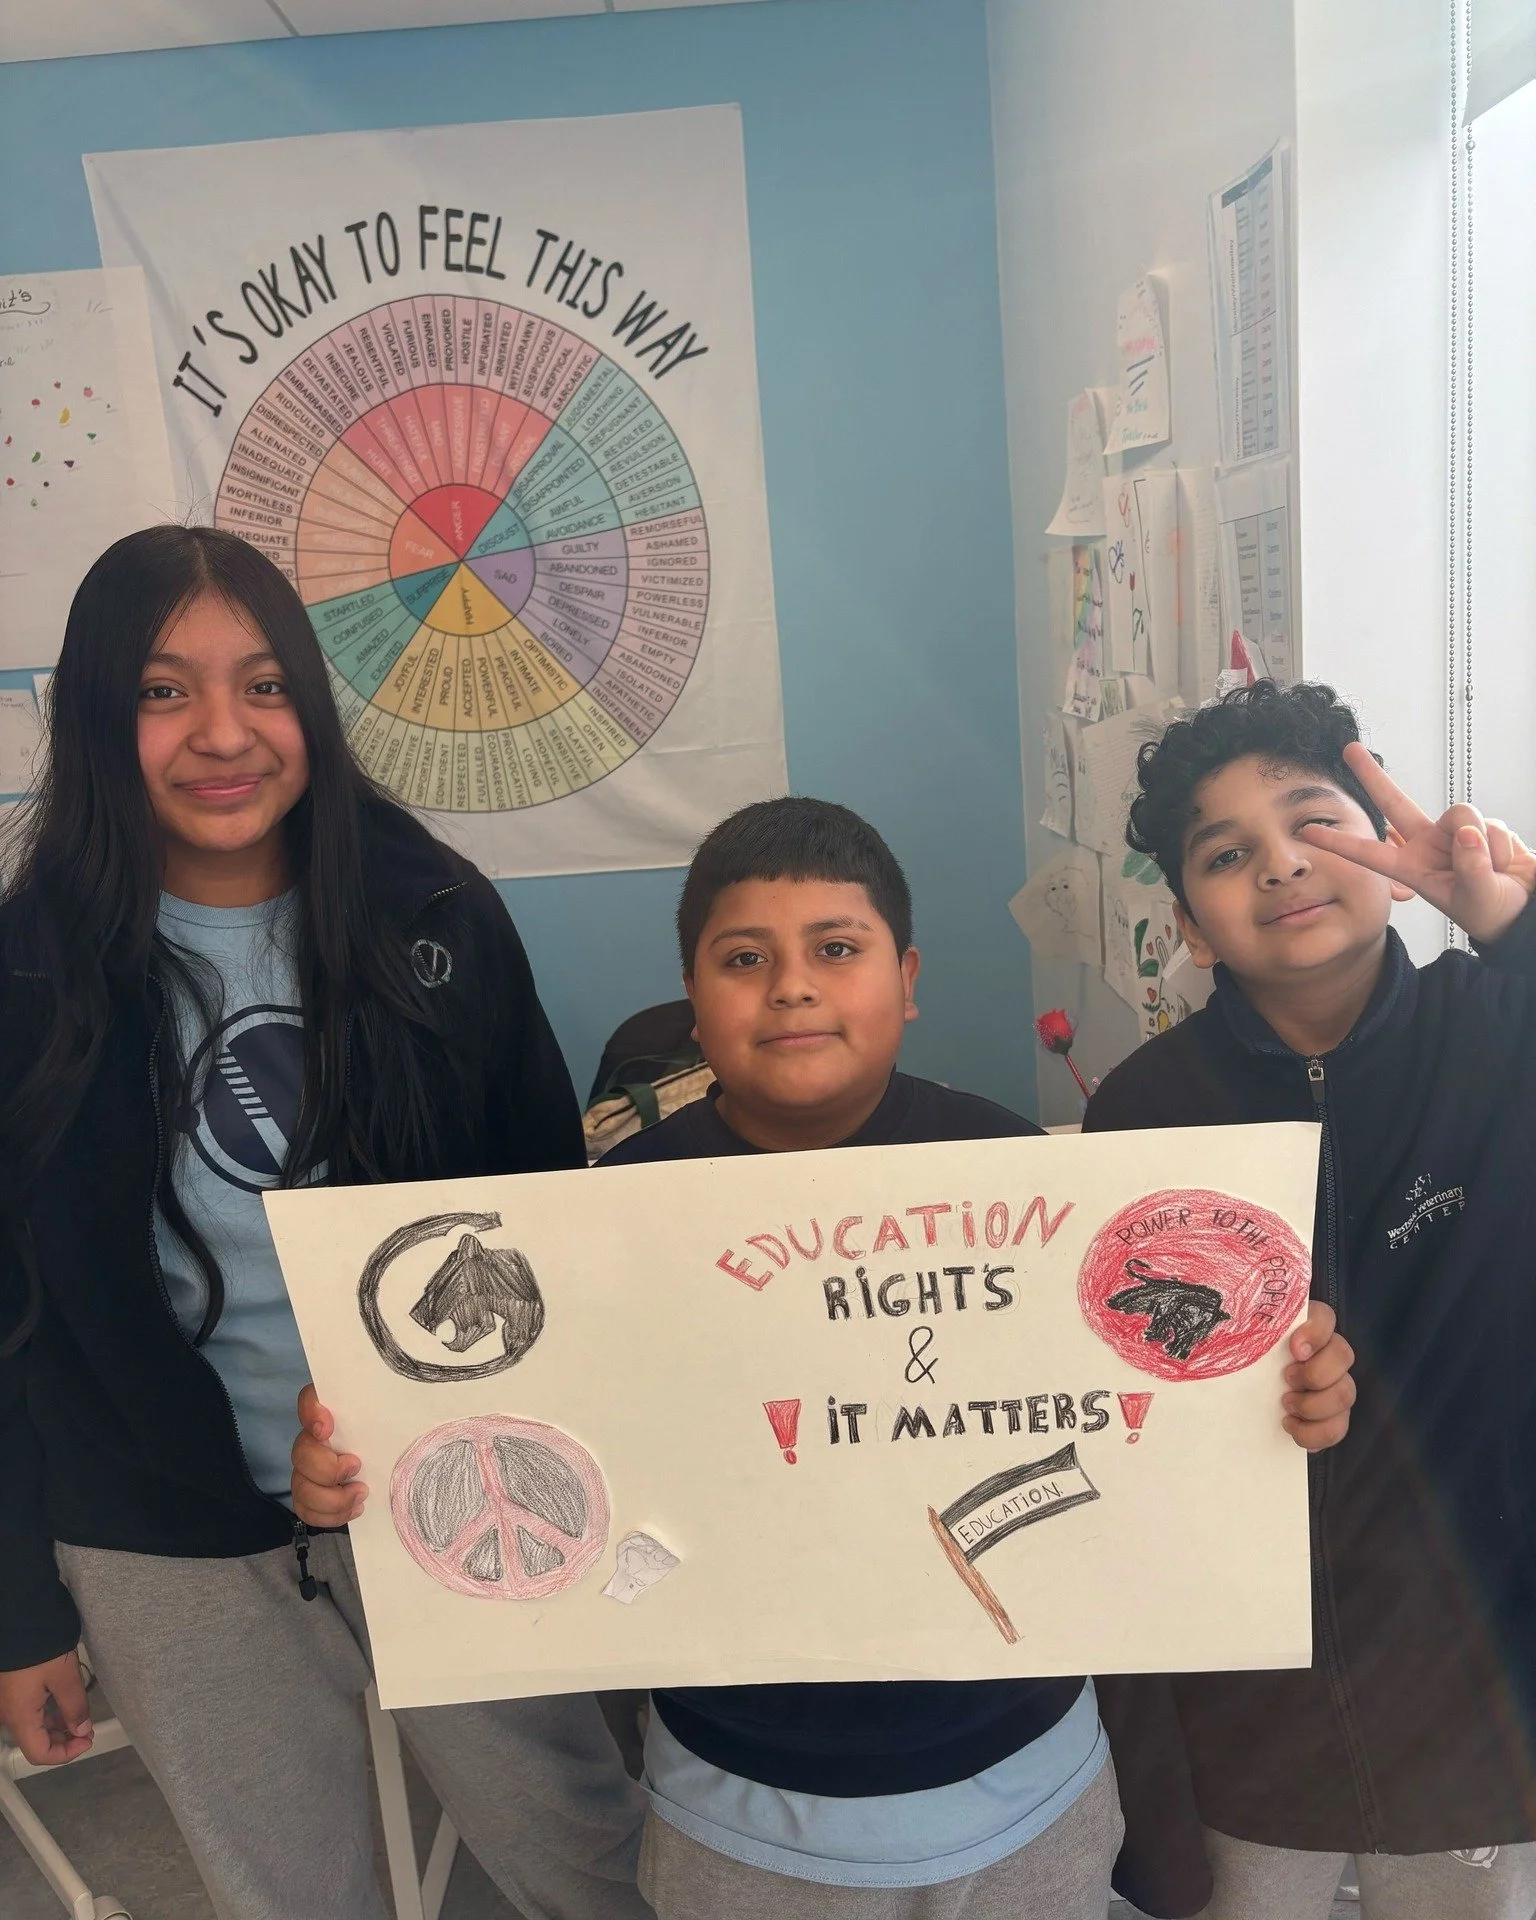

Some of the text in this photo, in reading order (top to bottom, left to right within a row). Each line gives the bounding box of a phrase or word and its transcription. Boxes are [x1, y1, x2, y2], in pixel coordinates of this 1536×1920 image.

[173, 205, 710, 418] IT'S OKAY TO FEEL THIS WAY
[360, 328, 389, 389] RESENTFUL
[382, 324, 405, 376] VIOLATED
[403, 320, 420, 369] FURIOUS
[422, 313, 437, 367] ENRAGED
[443, 309, 454, 371] PROVOKED
[462, 319, 472, 365] HOSTILE
[478, 313, 492, 376] INFURIATED
[496, 322, 512, 377] IRRITATED
[507, 321, 535, 390] WITHDRAWN
[326, 354, 359, 402] INSECURE
[343, 343, 374, 392] JEALOUS
[524, 329, 556, 397] SUSPICIOUS
[541, 347, 573, 399] SKEPTICAL
[553, 354, 593, 411] SARCASTIC
[284, 371, 343, 435] EMBARRASSED
[302, 358, 352, 420] DEVASTATED
[583, 386, 624, 431] LOATHING
[256, 404, 323, 458] DISRESPECTED
[276, 392, 325, 439] RIDICULED
[589, 397, 643, 448] REPUGNANT
[250, 427, 307, 466] ALIENATED
[604, 419, 653, 458] REVOLTED
[610, 434, 666, 474] REVULSION
[230, 462, 300, 498] INSIGNIFICANT
[238, 444, 304, 482] INADEQUATE
[512, 440, 566, 499] DISAPPROVAL
[614, 453, 680, 491] DETESTABLE
[226, 485, 293, 514] WORTHLESS
[522, 457, 585, 513] DISAPPOINTED
[628, 476, 681, 503] AVERSION
[230, 507, 282, 527] INFERIOR
[546, 514, 605, 540] AVOIDANCE
[550, 495, 584, 518] AWFUL
[631, 514, 703, 536] REMORSEFUL
[634, 496, 686, 517] HESITANT
[478, 524, 520, 553] DISGUST
[562, 541, 600, 554] GUILTY
[647, 536, 698, 550] ASHAMED
[494, 570, 517, 583] SAD
[550, 560, 617, 576] ABANDONED
[641, 575, 703, 585] VICTIMIZED
[647, 556, 697, 567] IGNORED
[323, 594, 375, 621] STARTLED
[547, 596, 610, 629] DEPRESSED
[559, 582, 605, 601] DESPAIR
[636, 591, 703, 608] POWERLESS
[333, 608, 383, 645] CONFUSED
[553, 618, 591, 645] LONELY
[632, 606, 701, 630] VULNERABLE
[638, 625, 688, 648] INFERIOR
[356, 629, 389, 662] AMAZED
[371, 641, 403, 682] EXCITED
[523, 638, 568, 691] OPTIMISTIC
[540, 632, 573, 663] BORED
[641, 644, 676, 664] EMPTY
[394, 654, 418, 693] JOYFUL
[412, 647, 439, 714] INTERESTED
[440, 666, 453, 706] PROUD
[464, 658, 472, 717] ACCEPTED
[480, 657, 496, 718] POWERFUL
[495, 657, 520, 711] PEACEFUL
[510, 649, 541, 694] INTIMATE
[617, 669, 663, 703] ISOLATED
[619, 652, 680, 689] ABANDONED
[592, 687, 647, 740] INDIFFERENT
[605, 680, 655, 721] APATHETIC
[565, 725, 593, 767] PLAYFUL
[582, 724, 605, 751] OPEN
[588, 706, 627, 748] INSPIRED
[436, 743, 449, 805] CONFIDENT
[457, 743, 466, 807] RESPECTED
[474, 747, 485, 804] FULFILLED
[486, 734, 505, 809] COURAGEOUS
[502, 732, 526, 806] PROVOCATIVE
[523, 748, 542, 788] LOVING
[535, 738, 559, 786] HOPEFUL
[549, 729, 581, 782] SENSITIVE
[1116, 1208, 1289, 1323] POWER TO THE PEOPLE
[905, 1325, 939, 1384] &
